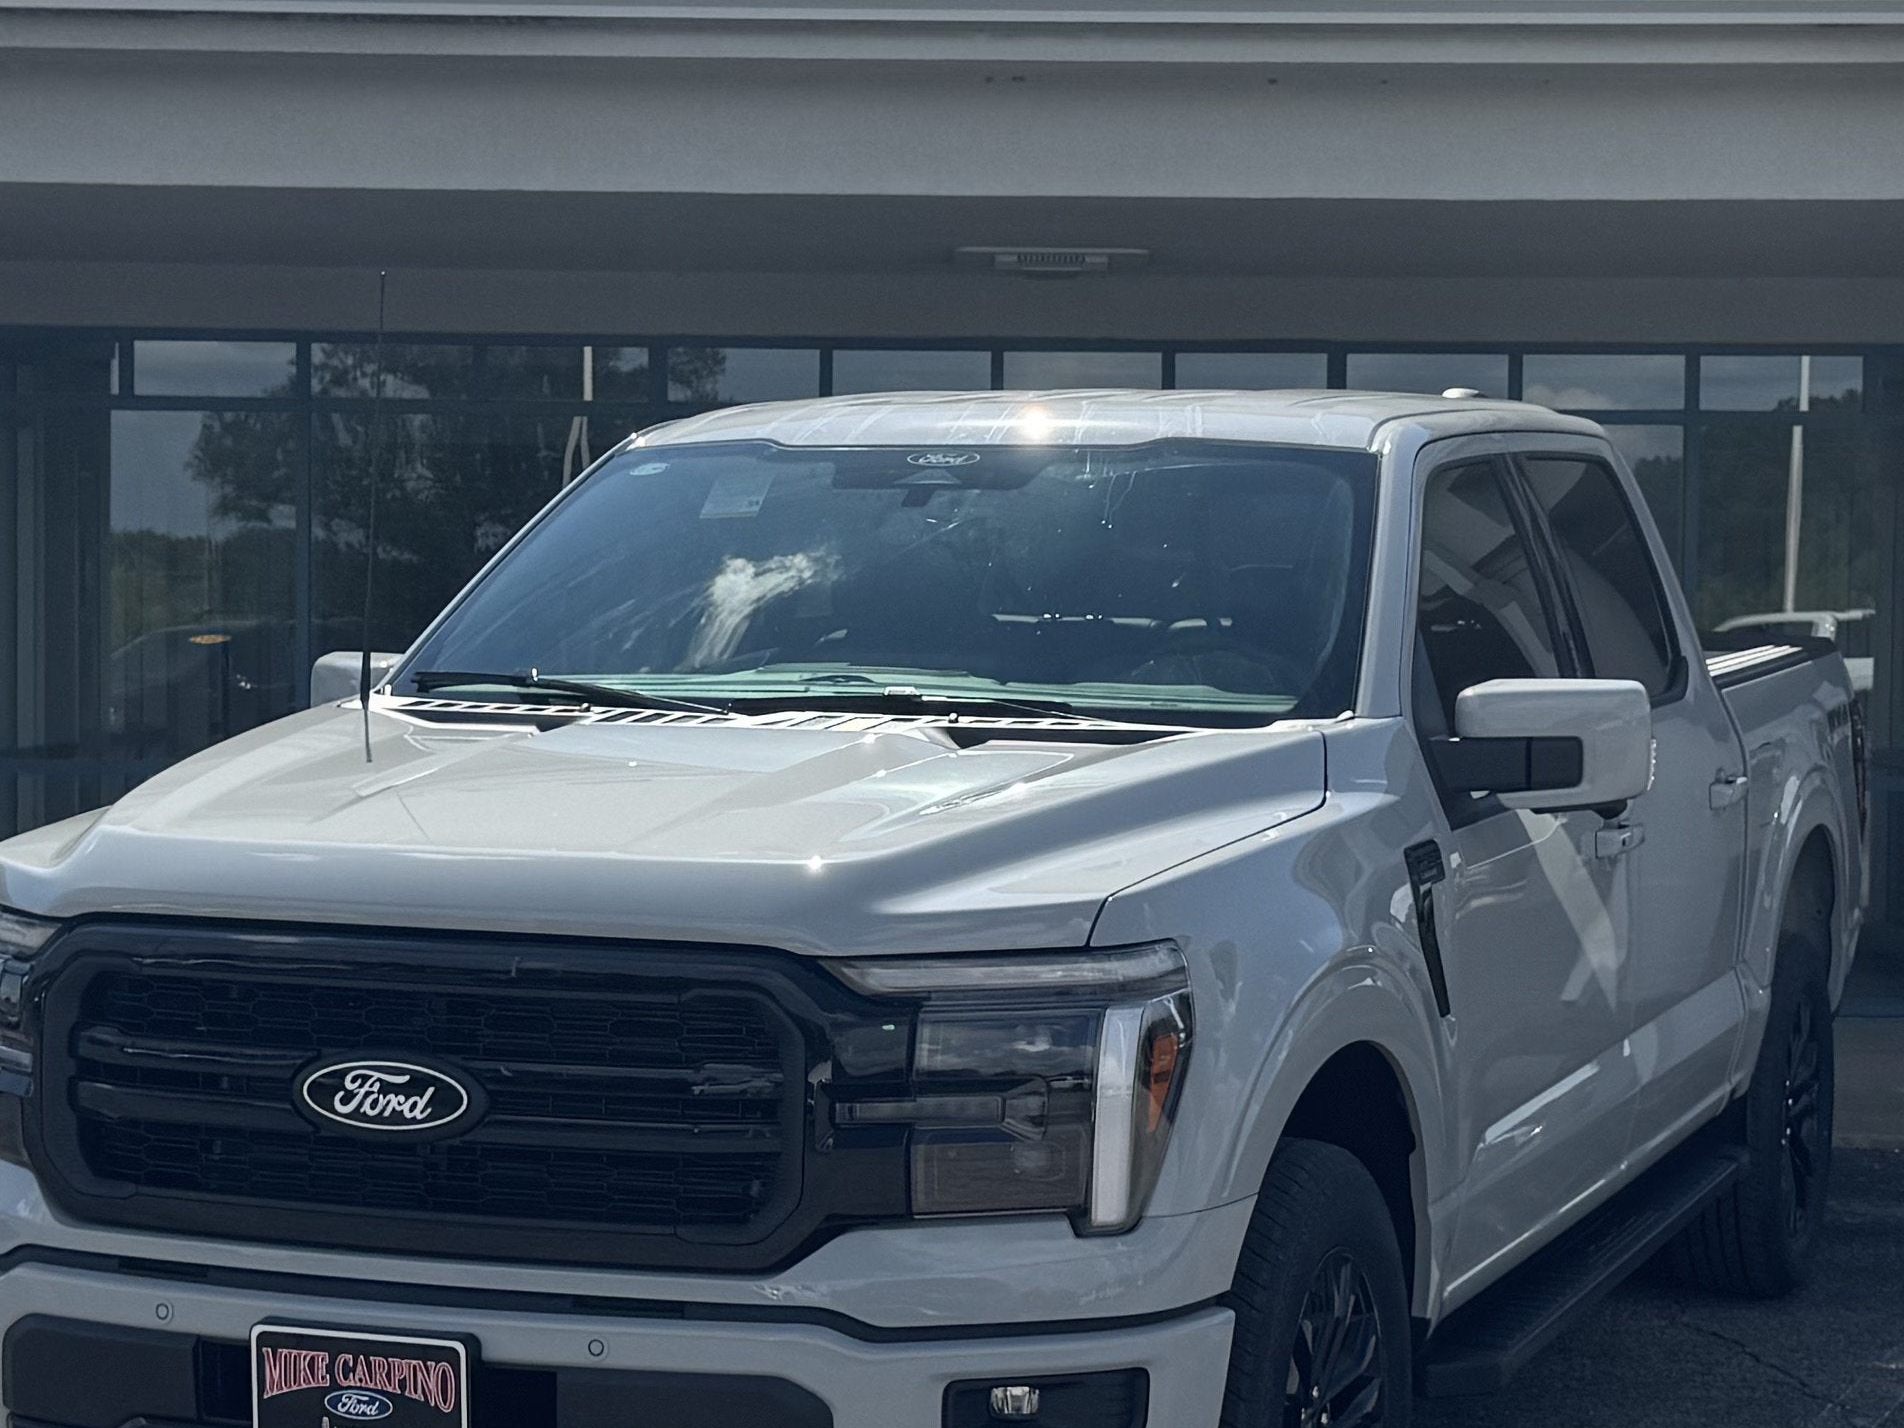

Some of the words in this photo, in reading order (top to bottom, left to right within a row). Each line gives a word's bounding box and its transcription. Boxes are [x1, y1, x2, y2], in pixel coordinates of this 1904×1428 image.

[333, 1069, 435, 1120] Ford
[262, 1347, 330, 1400] MIKE
[334, 1353, 456, 1413] CARPINO
[337, 1394, 380, 1416] Ford
